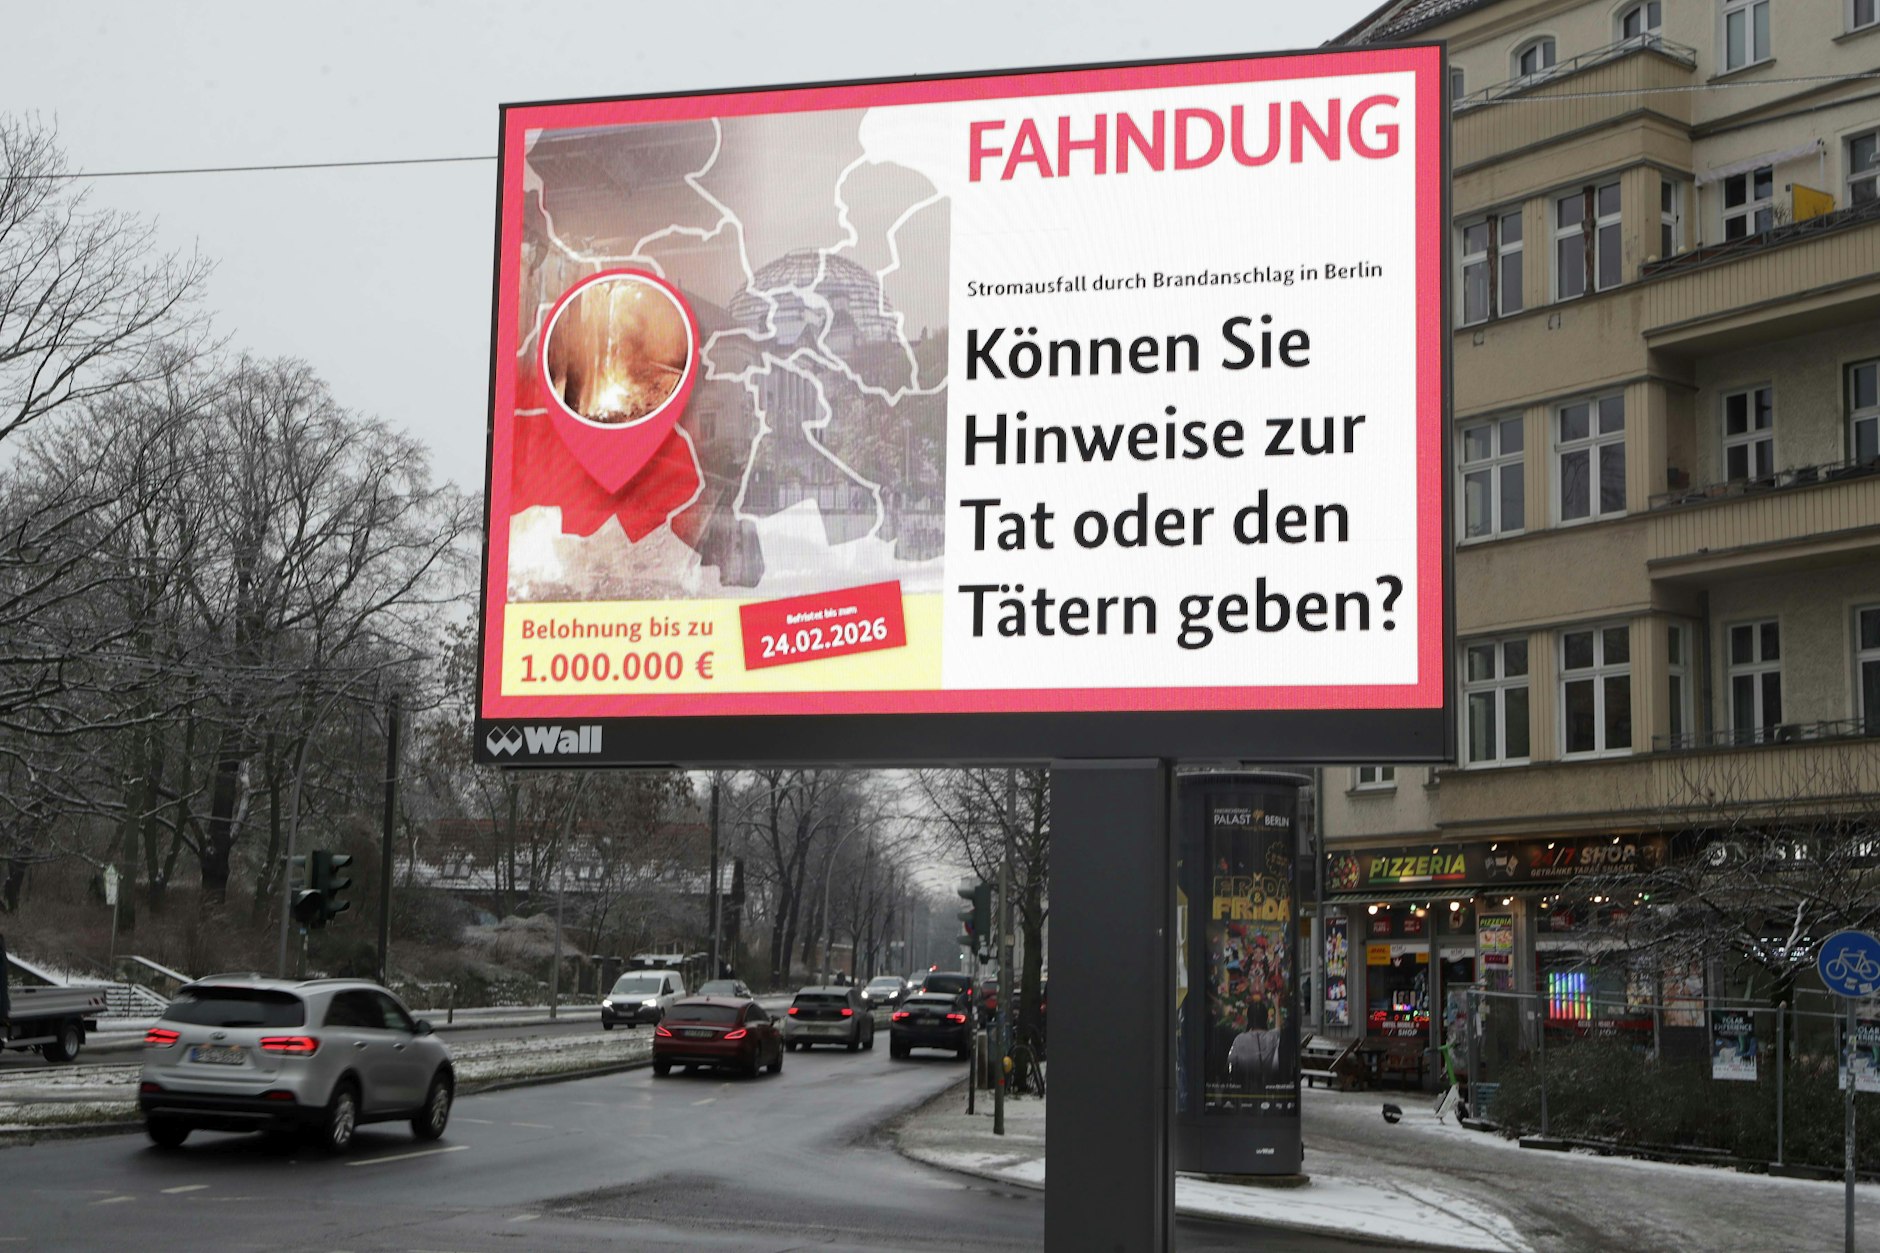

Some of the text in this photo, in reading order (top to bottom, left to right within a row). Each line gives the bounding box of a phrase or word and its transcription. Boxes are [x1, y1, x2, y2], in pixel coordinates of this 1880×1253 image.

[968, 94, 1400, 183] FAHNDUNG
[967, 261, 1383, 297] Stromausfall durch Brandanschlag in Berlin
[966, 313, 1311, 381] Können Sie
[964, 405, 1366, 466] Hinweise zur
[959, 488, 1349, 552] Tat oder den
[786, 605, 858, 625] Befristet bis zum
[958, 574, 1404, 650] Tätern geben?
[521, 616, 714, 643] Belohnung bis zu
[760, 617, 888, 659] 24.02.2026
[520, 650, 714, 683] 1.000.000 €
[523, 725, 603, 755] Wall
[1214, 814, 1289, 828] PALAST BERLIN
[1368, 853, 1466, 878] PIZZERIA
[1530, 844, 1636, 867] 24/7 SHOP
[1212, 896, 1291, 922] FRIDA
[1480, 918, 1512, 927] PIZZERIA
[1398, 1029, 1418, 1037] SHOP
